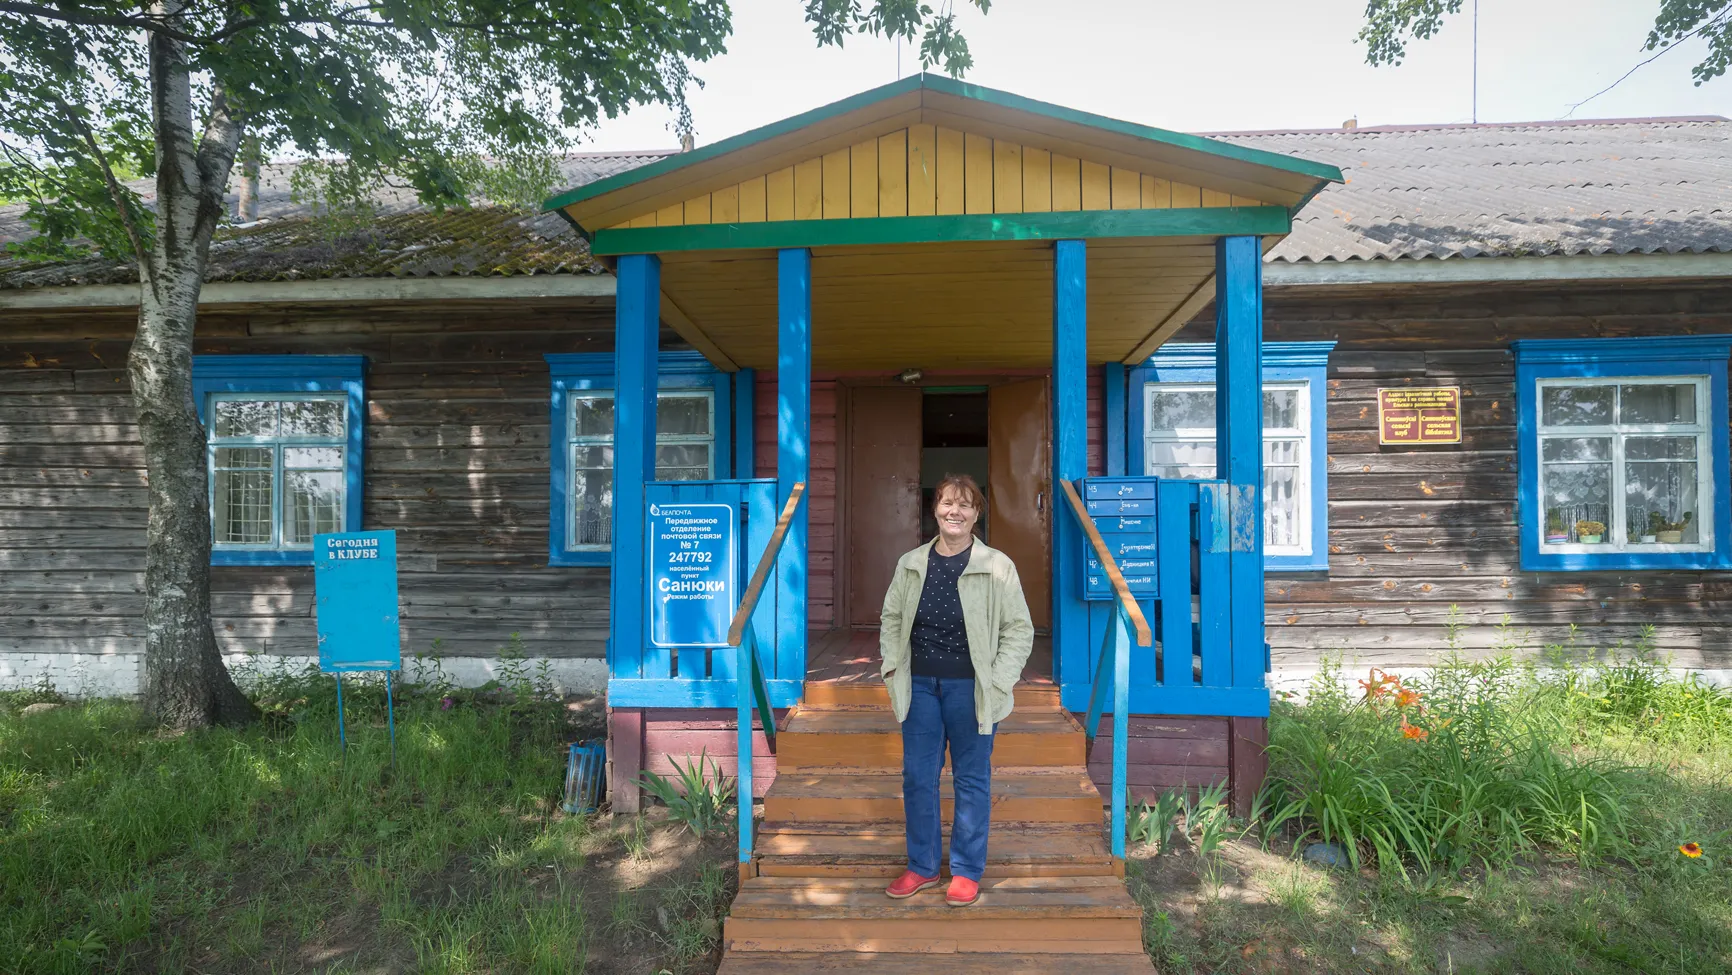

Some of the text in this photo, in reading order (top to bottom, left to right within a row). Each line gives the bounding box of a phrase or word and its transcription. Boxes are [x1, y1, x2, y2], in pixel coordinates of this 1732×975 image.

[665, 517, 718, 525] Передвижное
[661, 532, 698, 540] почтовой
[327, 538, 378, 548] Сегодня
[680, 541, 700, 549] № 7
[328, 548, 378, 560] в КЛУБЕ
[668, 551, 712, 563] 247792
[658, 577, 725, 592] Санюки
